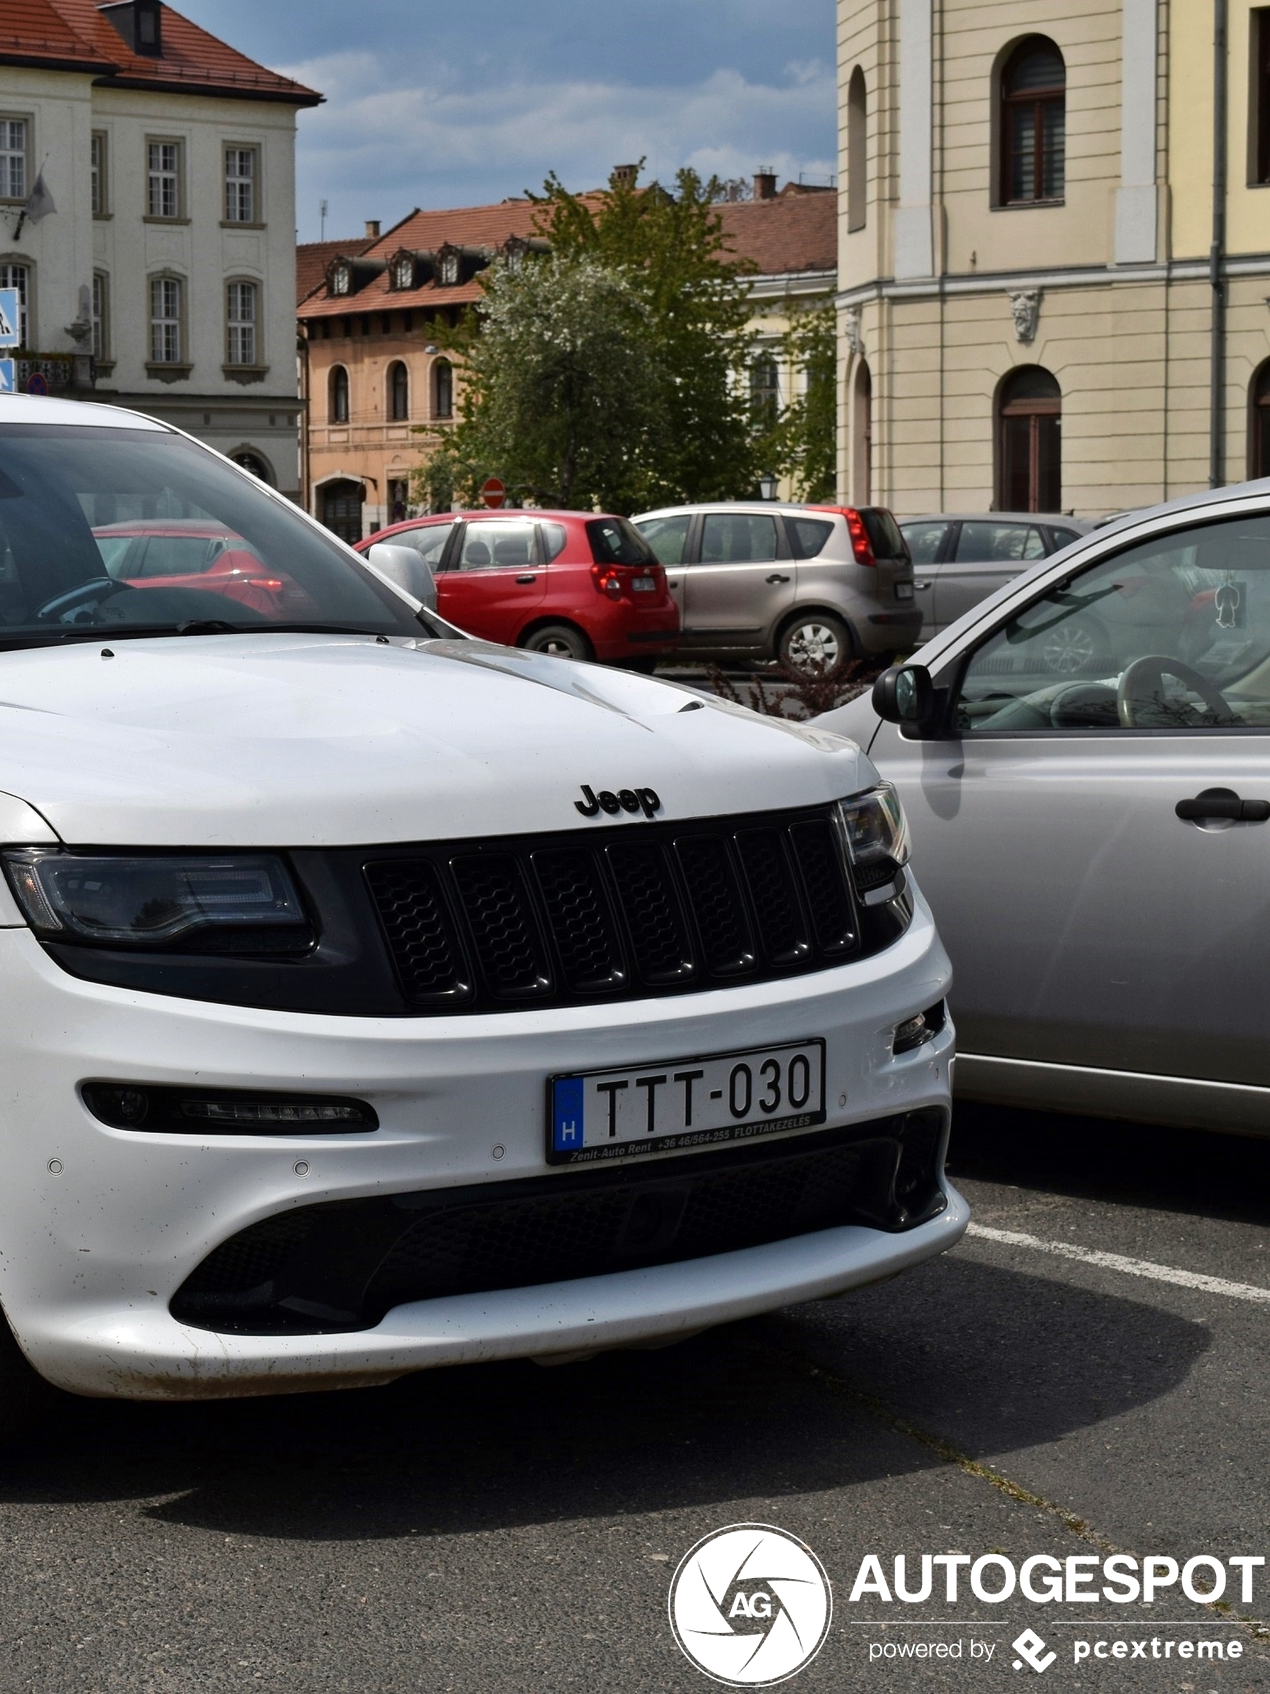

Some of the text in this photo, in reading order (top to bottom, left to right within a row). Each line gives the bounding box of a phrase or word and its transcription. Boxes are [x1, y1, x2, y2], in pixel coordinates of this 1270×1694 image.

[574, 784, 660, 819] Jeep
[597, 1053, 810, 1137] TTT-030
[562, 1120, 576, 1142] H
[628, 1142, 651, 1154] Rent
[658, 1138, 676, 1149] +36
[679, 1129, 730, 1146] 46/564-255
[734, 1115, 811, 1138] FLOTTAKEZELÉS
